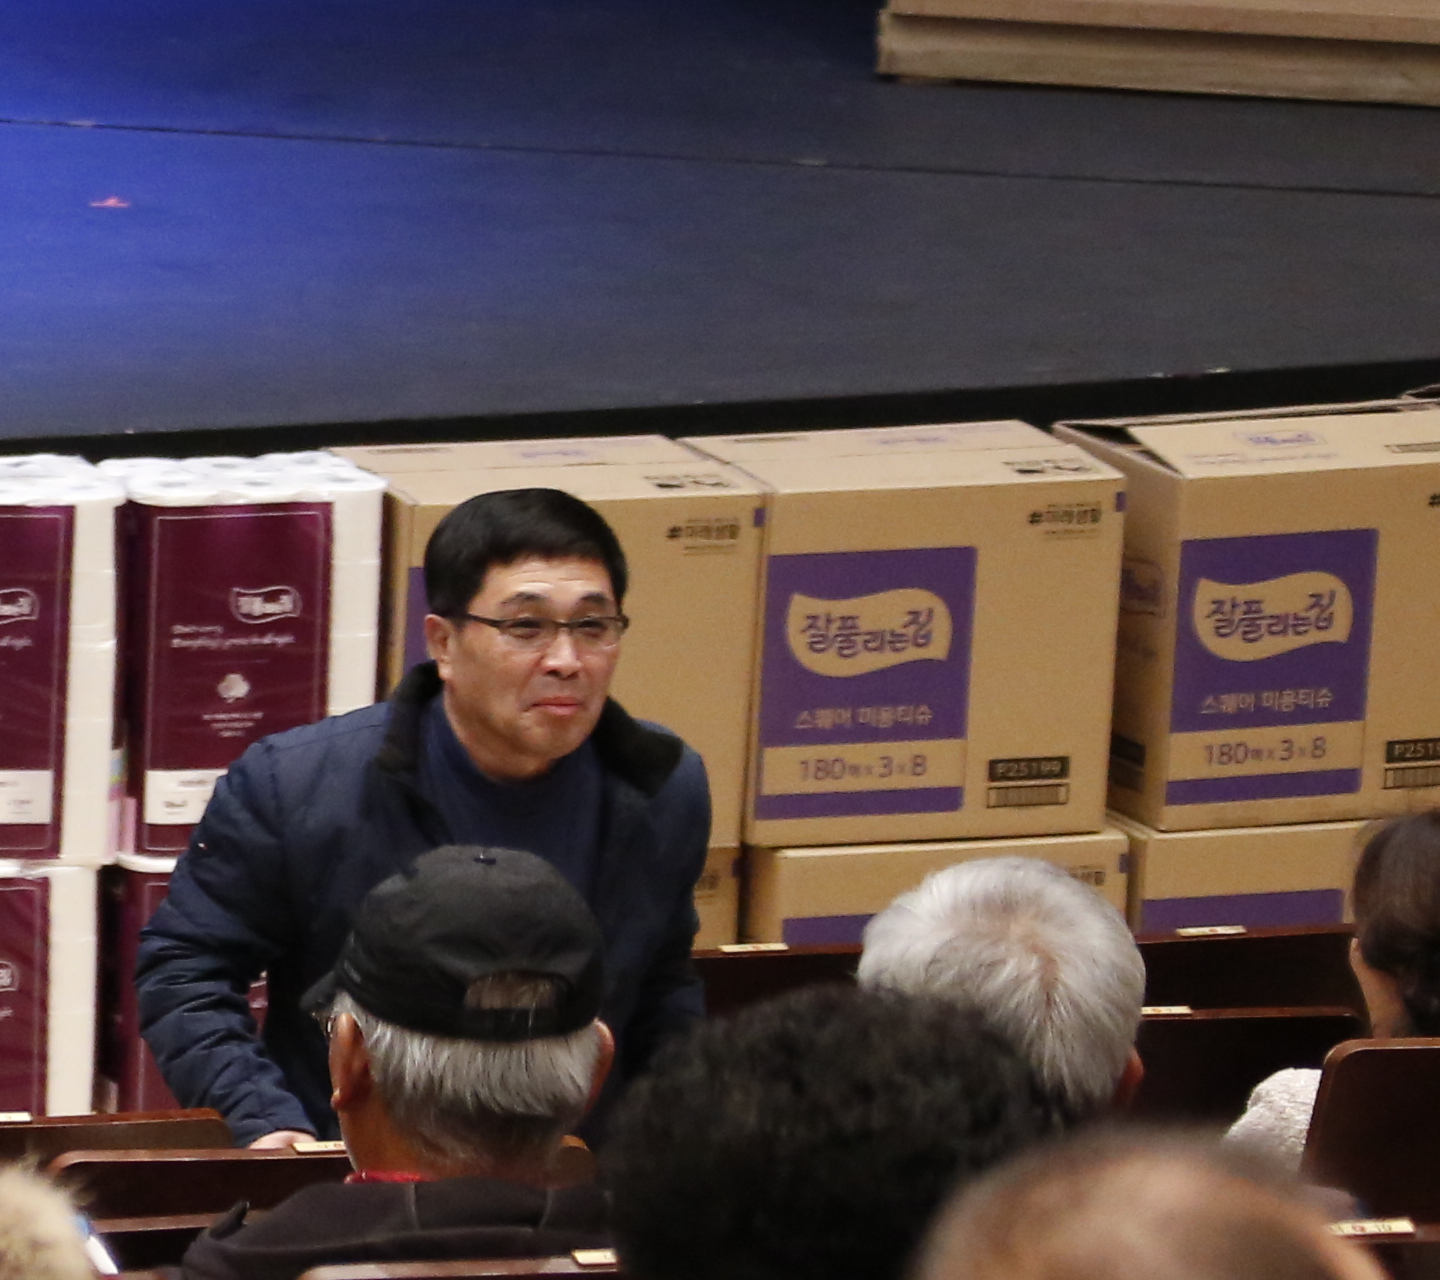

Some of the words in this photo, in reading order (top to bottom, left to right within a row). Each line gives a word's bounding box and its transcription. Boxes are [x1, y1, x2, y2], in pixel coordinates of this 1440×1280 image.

[801, 607, 937, 658] 잘풀리는집
[1206, 590, 1339, 644] 잘풀리는집
[1262, 686, 1333, 711] 미용티슈
